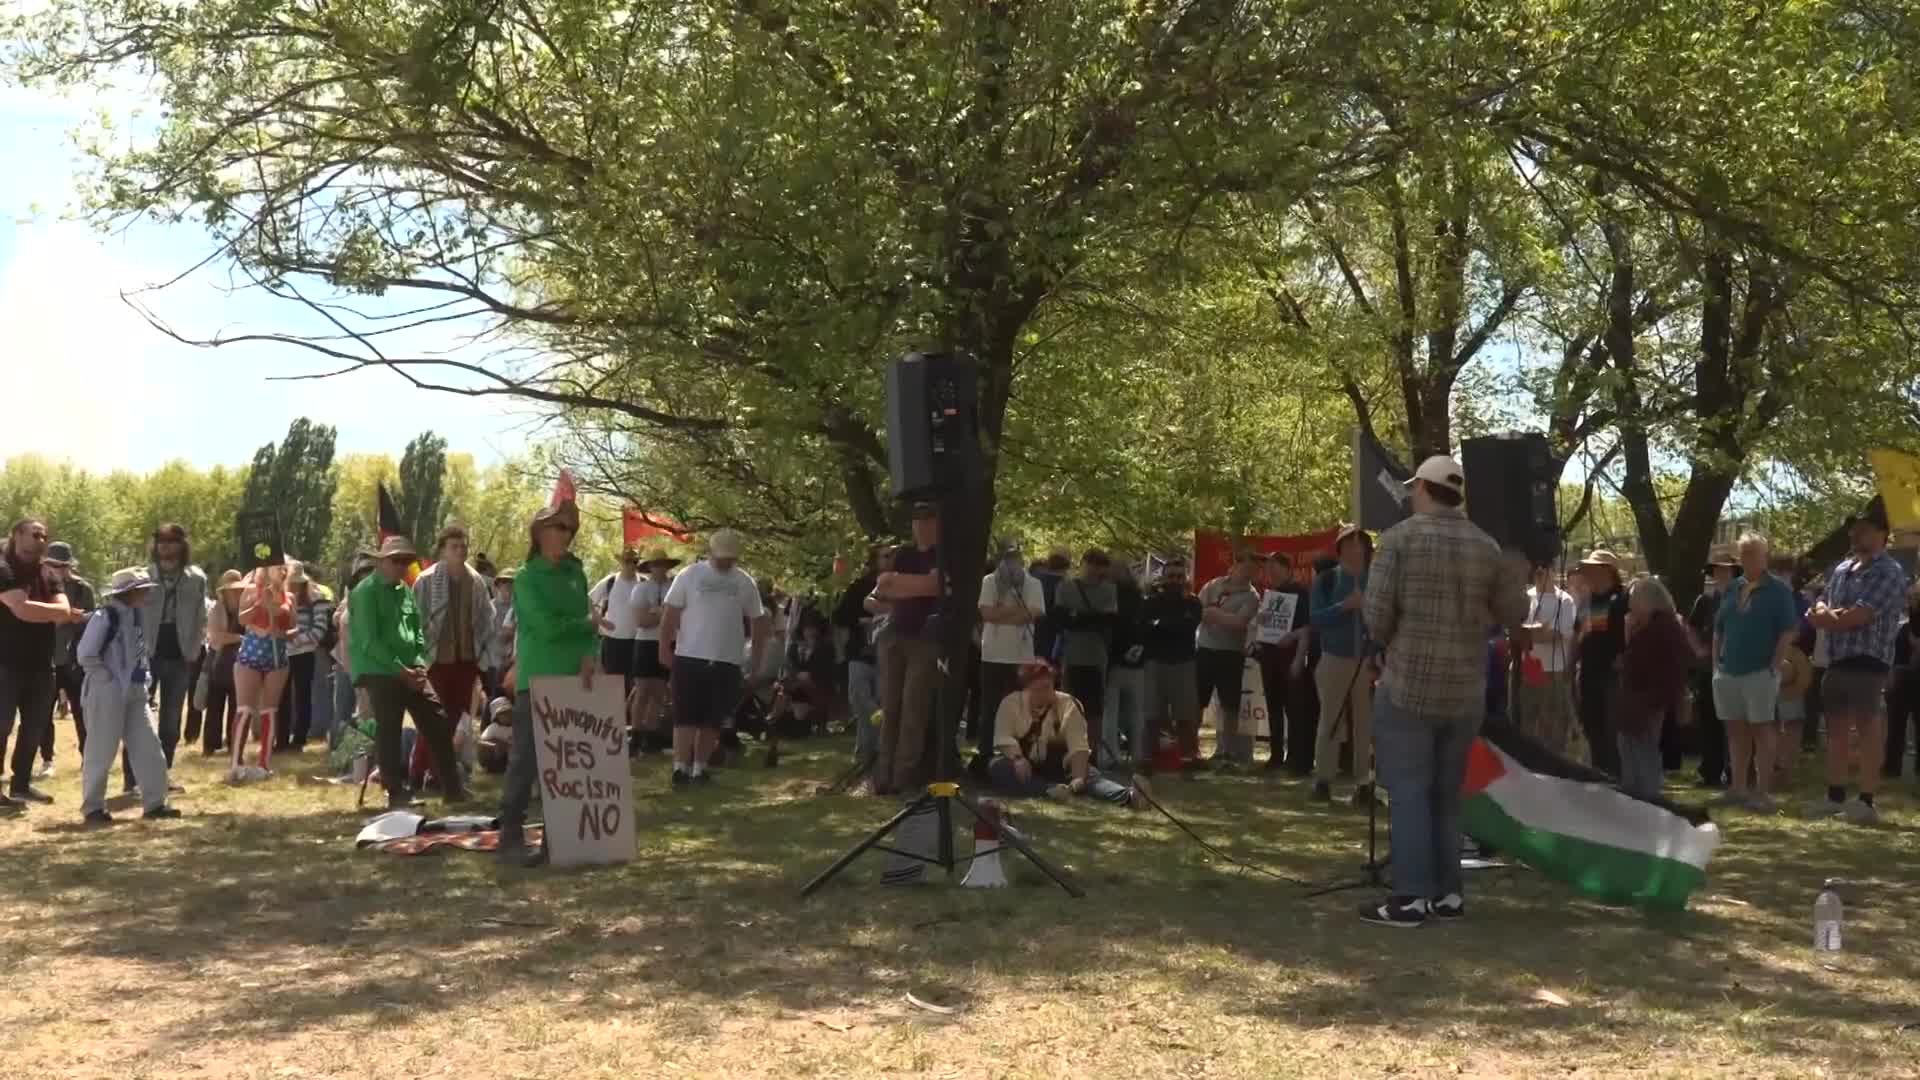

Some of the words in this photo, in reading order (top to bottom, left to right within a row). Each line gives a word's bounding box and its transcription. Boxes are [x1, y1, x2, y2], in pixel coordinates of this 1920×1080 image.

[535, 696, 624, 755] Humanity
[544, 736, 596, 770] YES
[543, 768, 621, 800] Racism
[578, 803, 621, 840] NO
